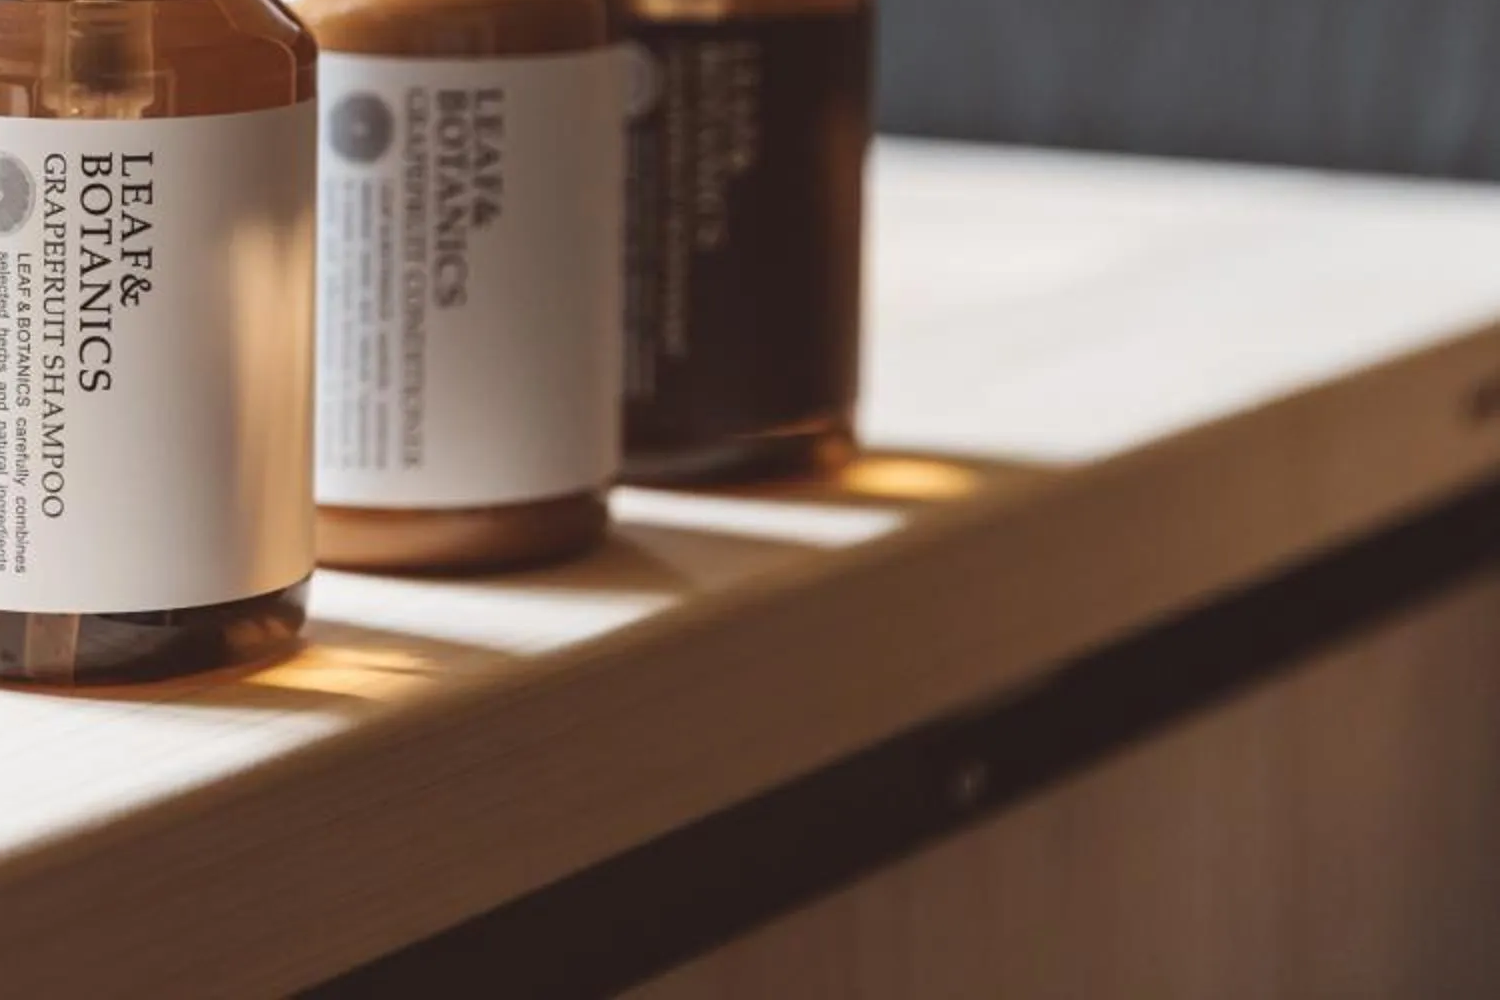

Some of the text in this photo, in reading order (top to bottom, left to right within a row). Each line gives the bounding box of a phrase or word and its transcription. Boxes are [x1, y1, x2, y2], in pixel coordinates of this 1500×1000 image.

[79, 152, 112, 392] BOTANICS
[120, 152, 153, 307] LEAF&
[434, 88, 470, 309] BOTANICS
[13, 253, 31, 573] LEAF & BOTANICS carefully combines
[42, 153, 66, 518] GRAPEFRUIT SHAMPOO
